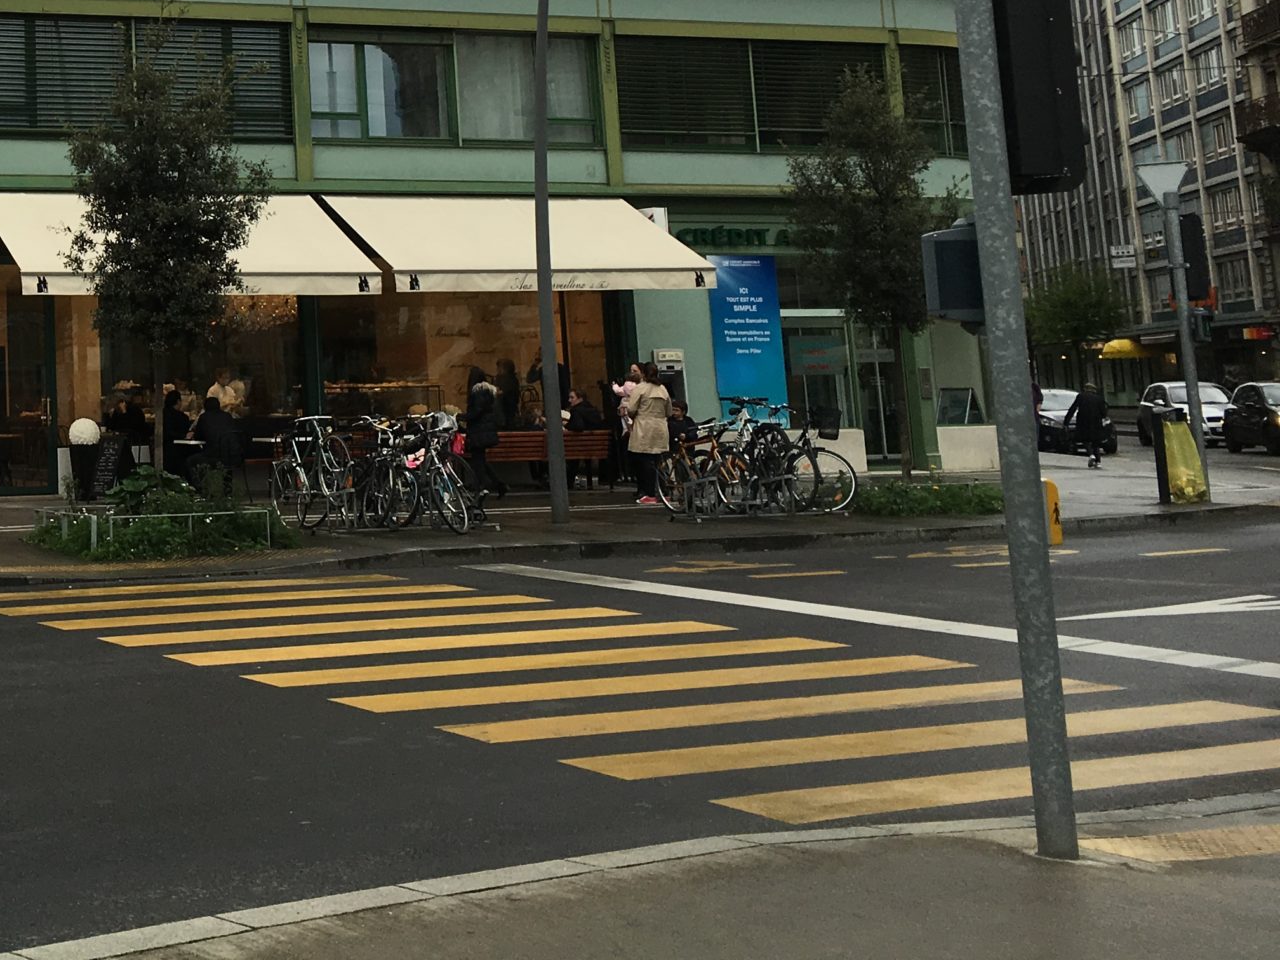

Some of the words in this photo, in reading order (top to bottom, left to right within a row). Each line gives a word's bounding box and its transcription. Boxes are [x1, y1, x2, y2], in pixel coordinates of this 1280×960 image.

[676, 225, 770, 247] CRÉDIT
[509, 272, 532, 290] Aux
[739, 287, 749, 295] ICI
